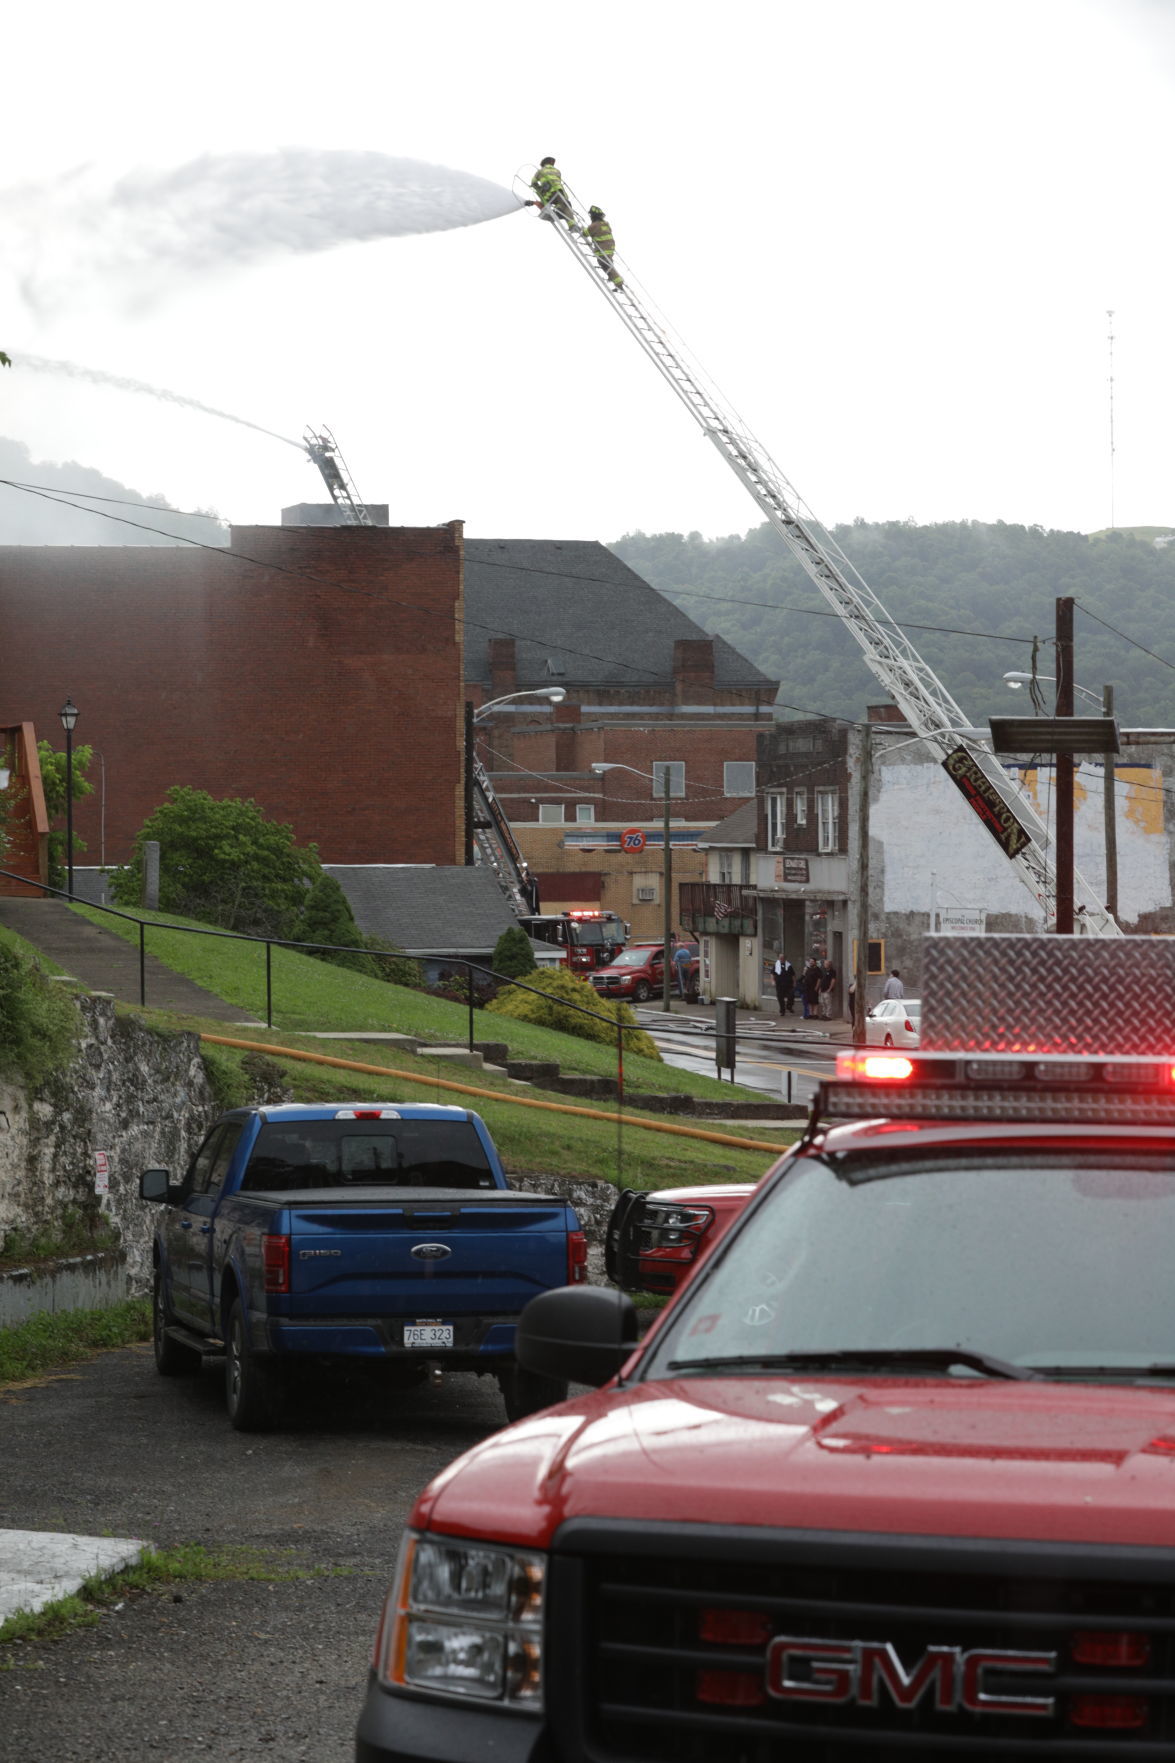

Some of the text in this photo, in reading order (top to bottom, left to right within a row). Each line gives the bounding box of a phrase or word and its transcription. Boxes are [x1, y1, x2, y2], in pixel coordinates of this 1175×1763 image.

[946, 752, 1027, 857] GRAFTON
[624, 833, 643, 848] 76
[419, 1247, 442, 1257] Ford
[405, 1328, 452, 1341] 76E 323
[766, 1635, 1057, 1718] GMC
